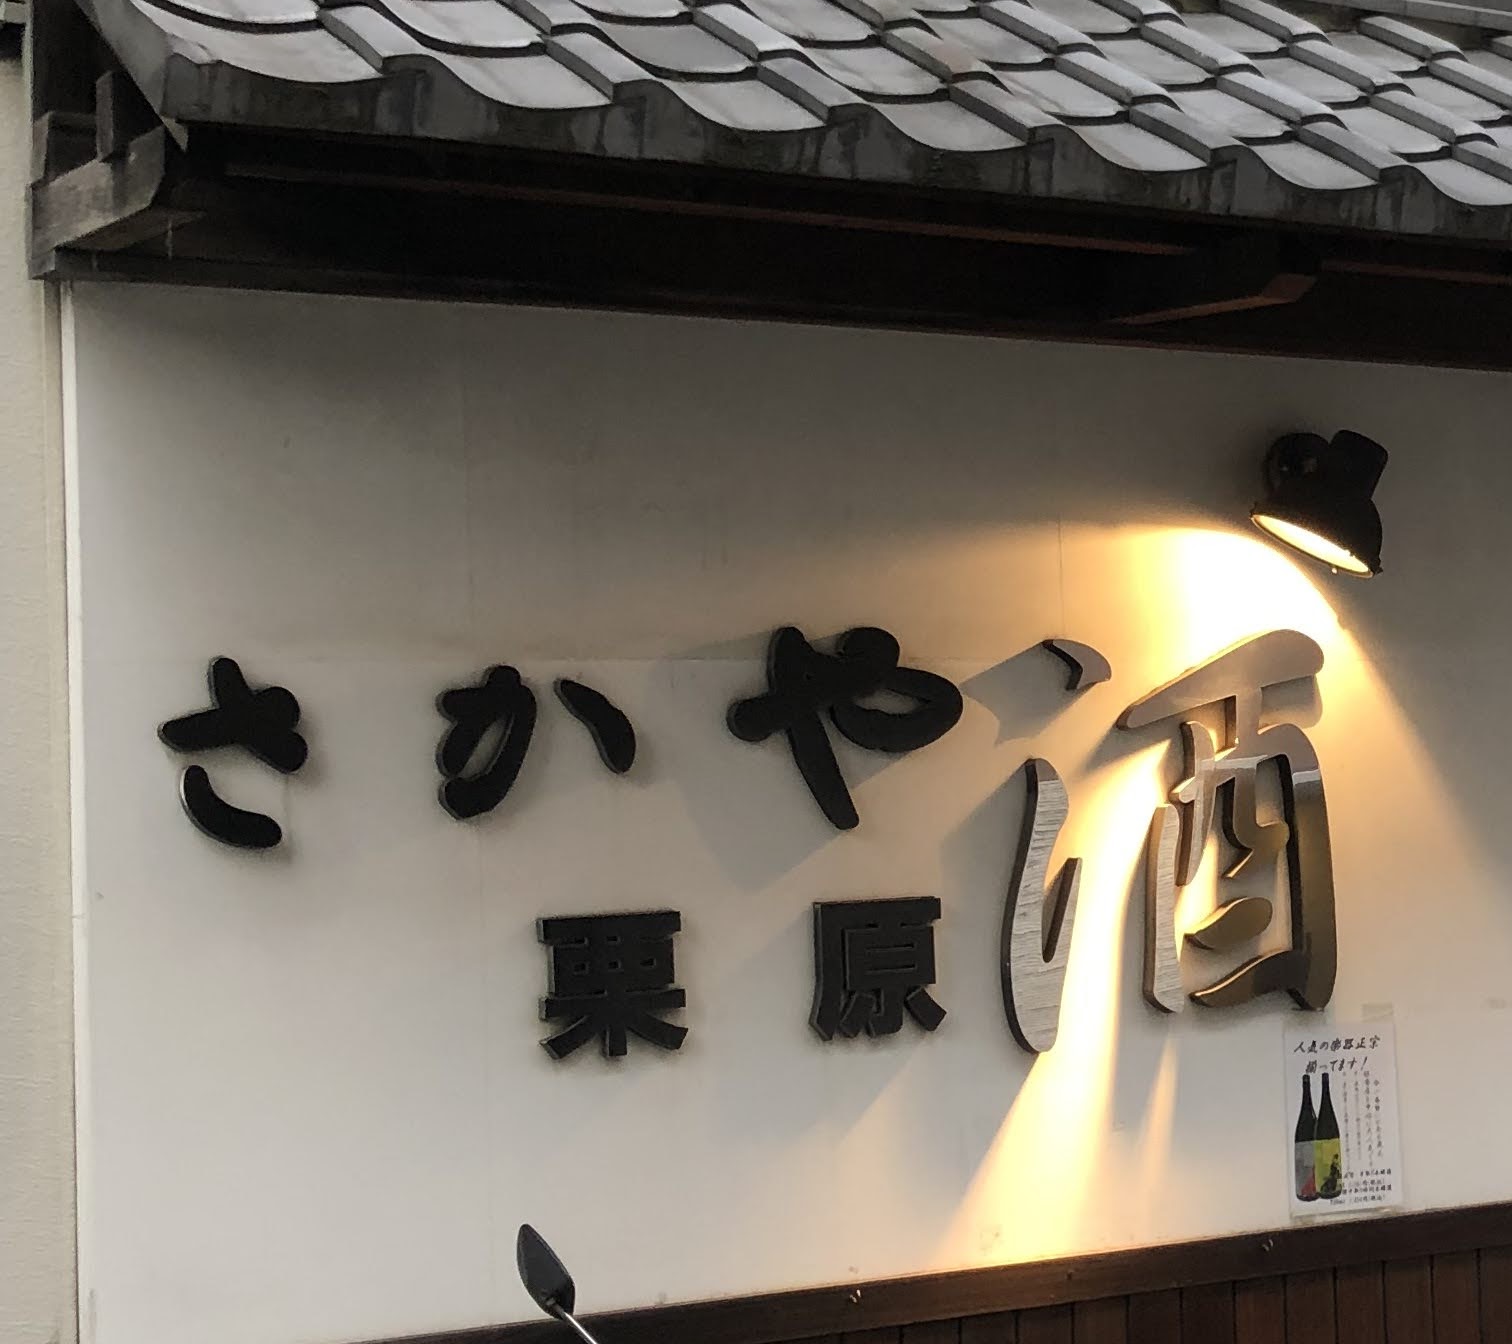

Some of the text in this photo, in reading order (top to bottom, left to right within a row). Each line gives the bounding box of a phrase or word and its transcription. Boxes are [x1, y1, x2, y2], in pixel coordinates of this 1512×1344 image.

[157, 625, 964, 850] さかや
[1000, 628, 1338, 1055] 酒
[535, 895, 946, 1060] 栗原
